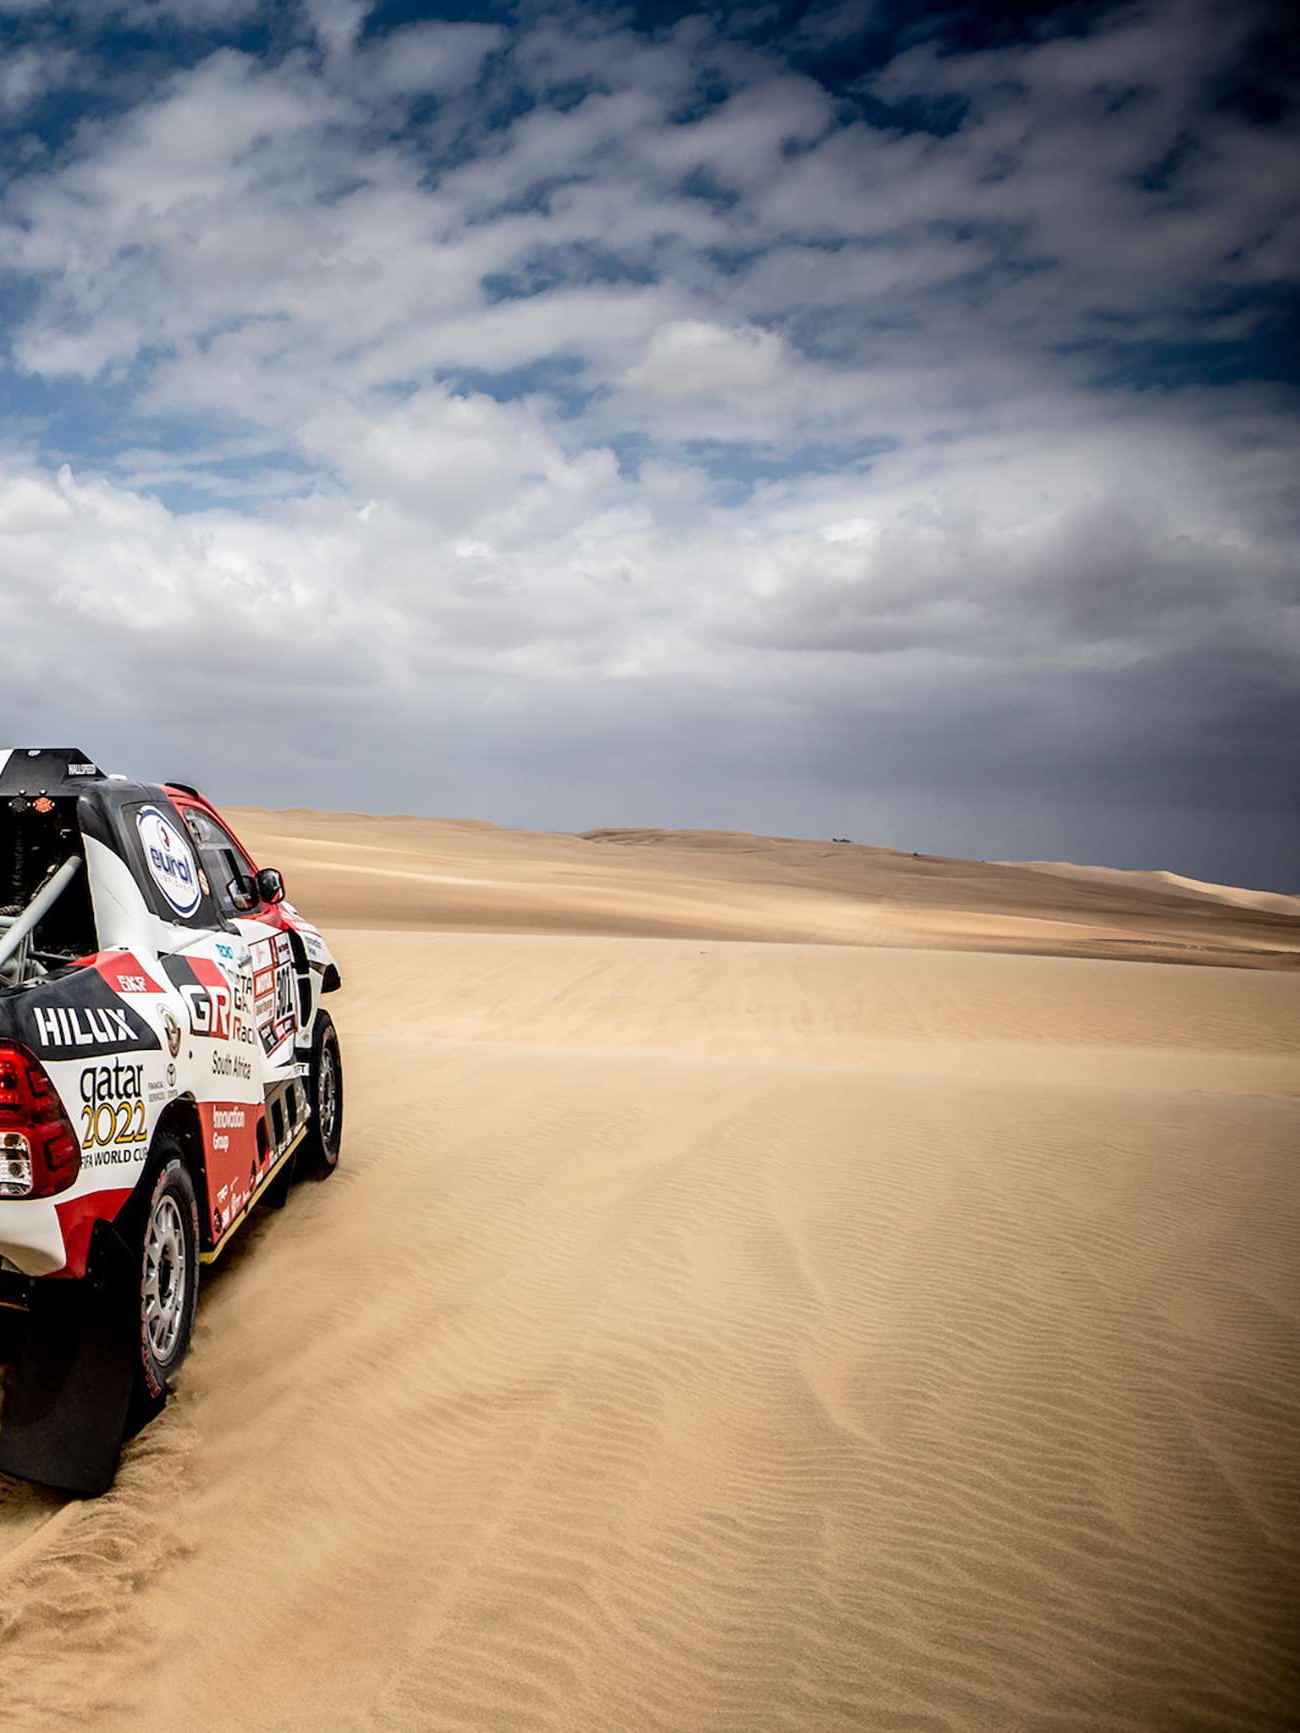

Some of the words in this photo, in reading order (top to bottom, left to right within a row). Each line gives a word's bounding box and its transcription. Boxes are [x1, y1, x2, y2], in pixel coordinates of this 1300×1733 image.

[150, 847, 193, 885] eurol
[116, 974, 148, 993] SKF
[32, 1006, 139, 1047] HILUX
[181, 983, 232, 1040] GR
[211, 1049, 232, 1076] South
[233, 1052, 251, 1080] Africa
[80, 1056, 144, 1112] qatar
[80, 1098, 148, 1150] 2022
[212, 1104, 245, 1129] Innovation
[93, 1149, 133, 1168] WORLD
[212, 1131, 230, 1153] Group
